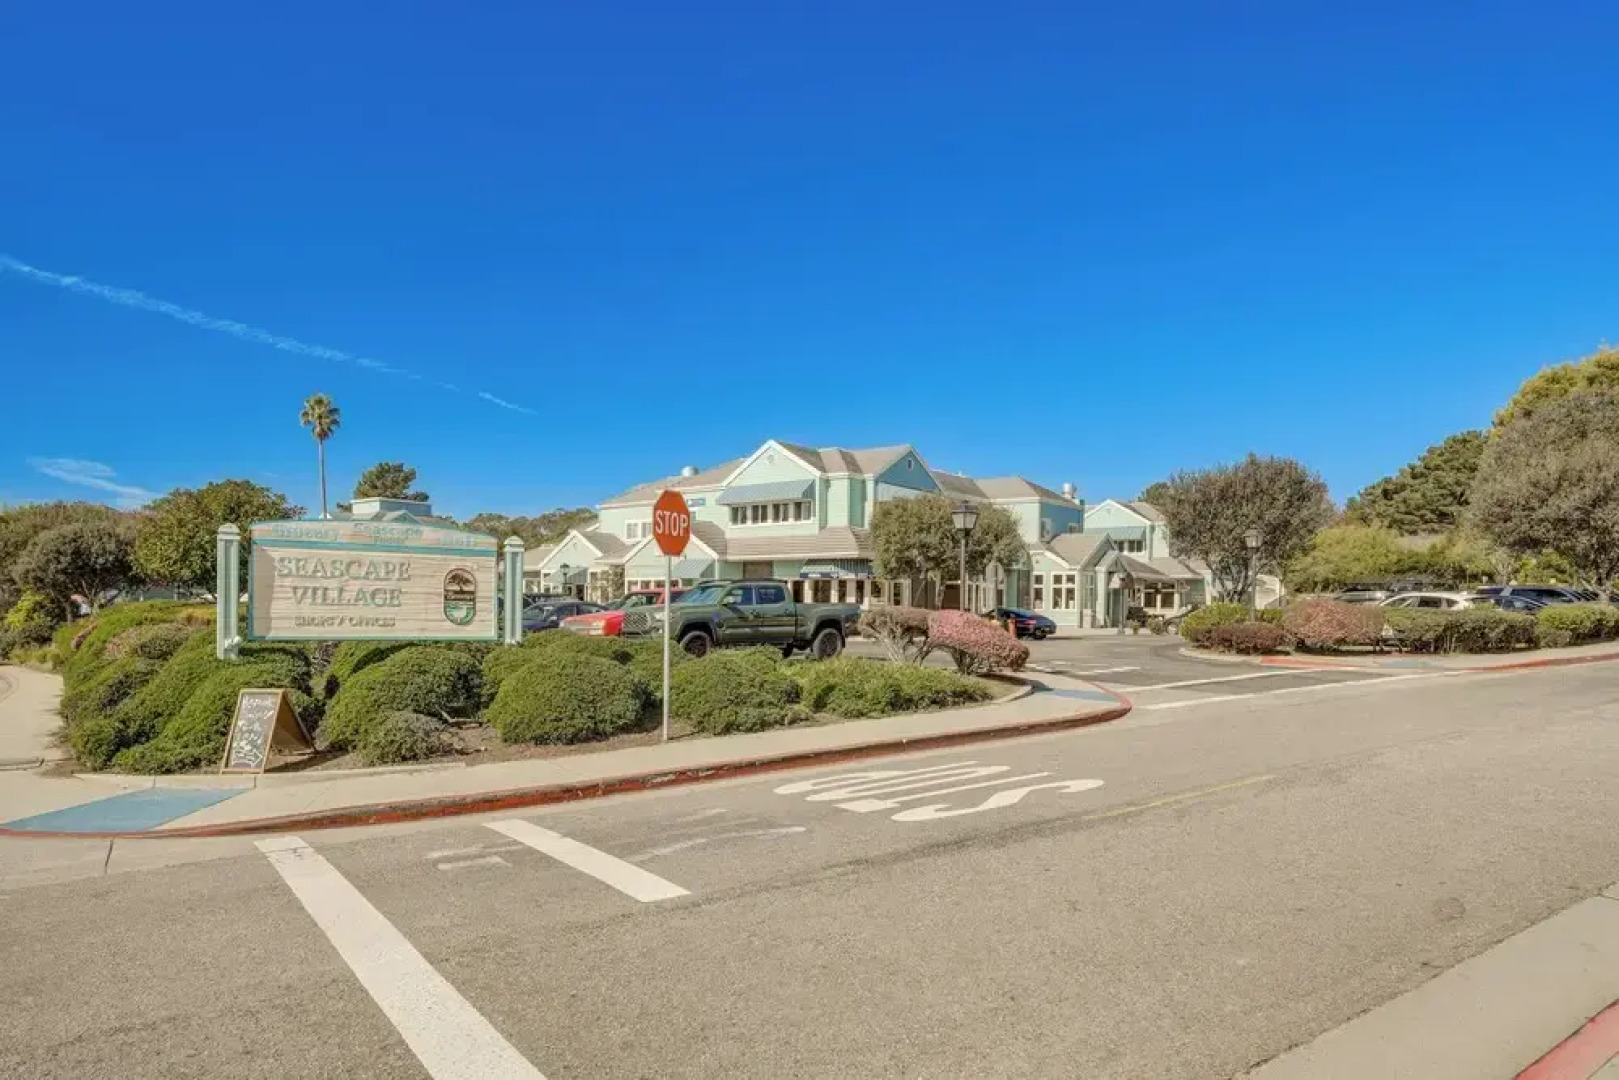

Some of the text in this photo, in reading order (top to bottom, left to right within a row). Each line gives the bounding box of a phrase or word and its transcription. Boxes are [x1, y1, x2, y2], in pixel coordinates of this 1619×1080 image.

[655, 509, 689, 537] STOP
[276, 556, 412, 581] SEASCAPE
[291, 585, 402, 608] VILLAGE
